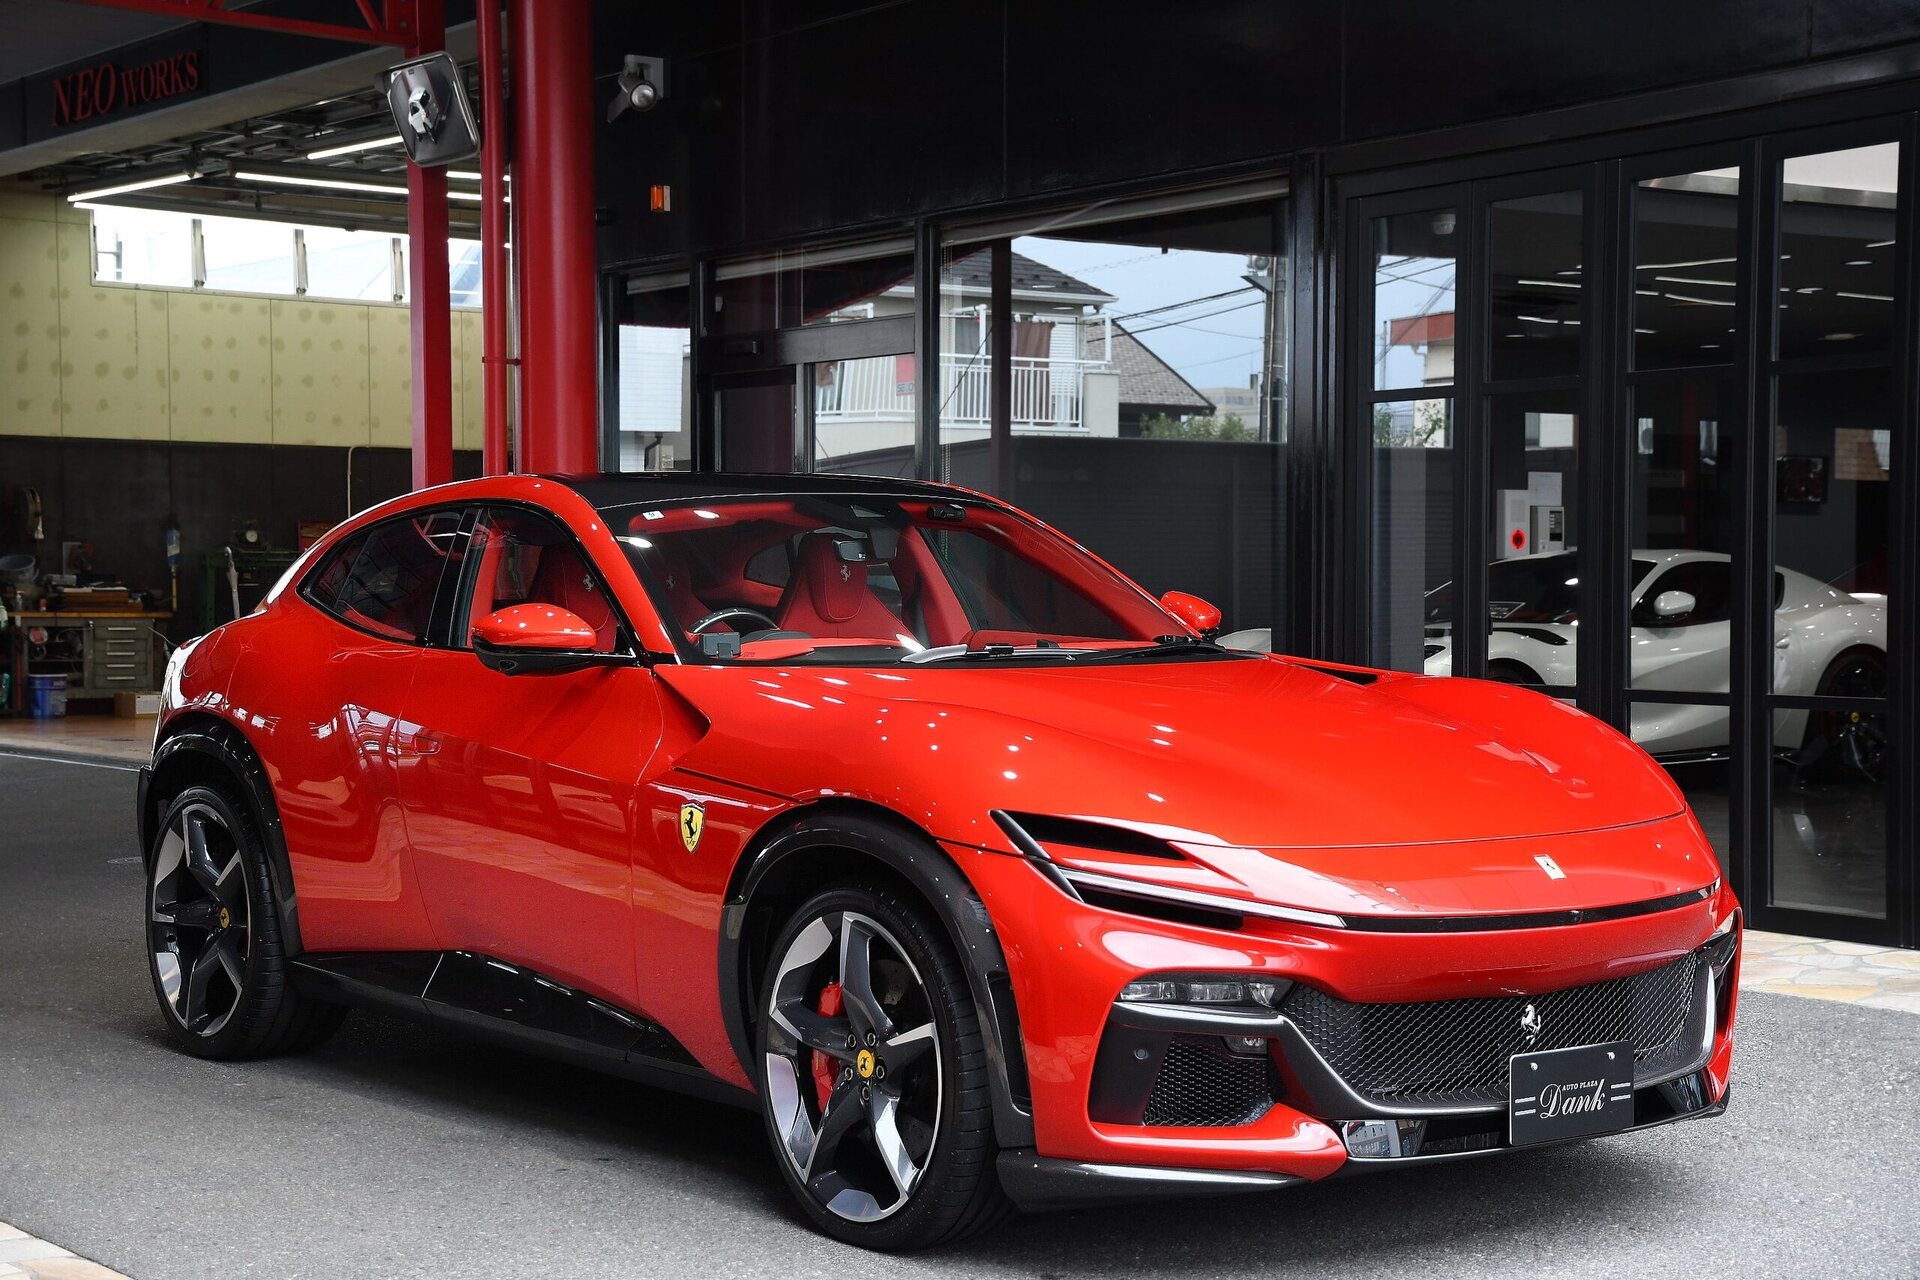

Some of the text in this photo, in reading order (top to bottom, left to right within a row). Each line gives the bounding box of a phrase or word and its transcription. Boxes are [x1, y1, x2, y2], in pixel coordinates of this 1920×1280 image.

[52, 51, 199, 128] NEO WORKS
[1540, 1078, 1605, 1119] Dank
[1562, 1080, 1598, 1092] AUTO PLAZA
